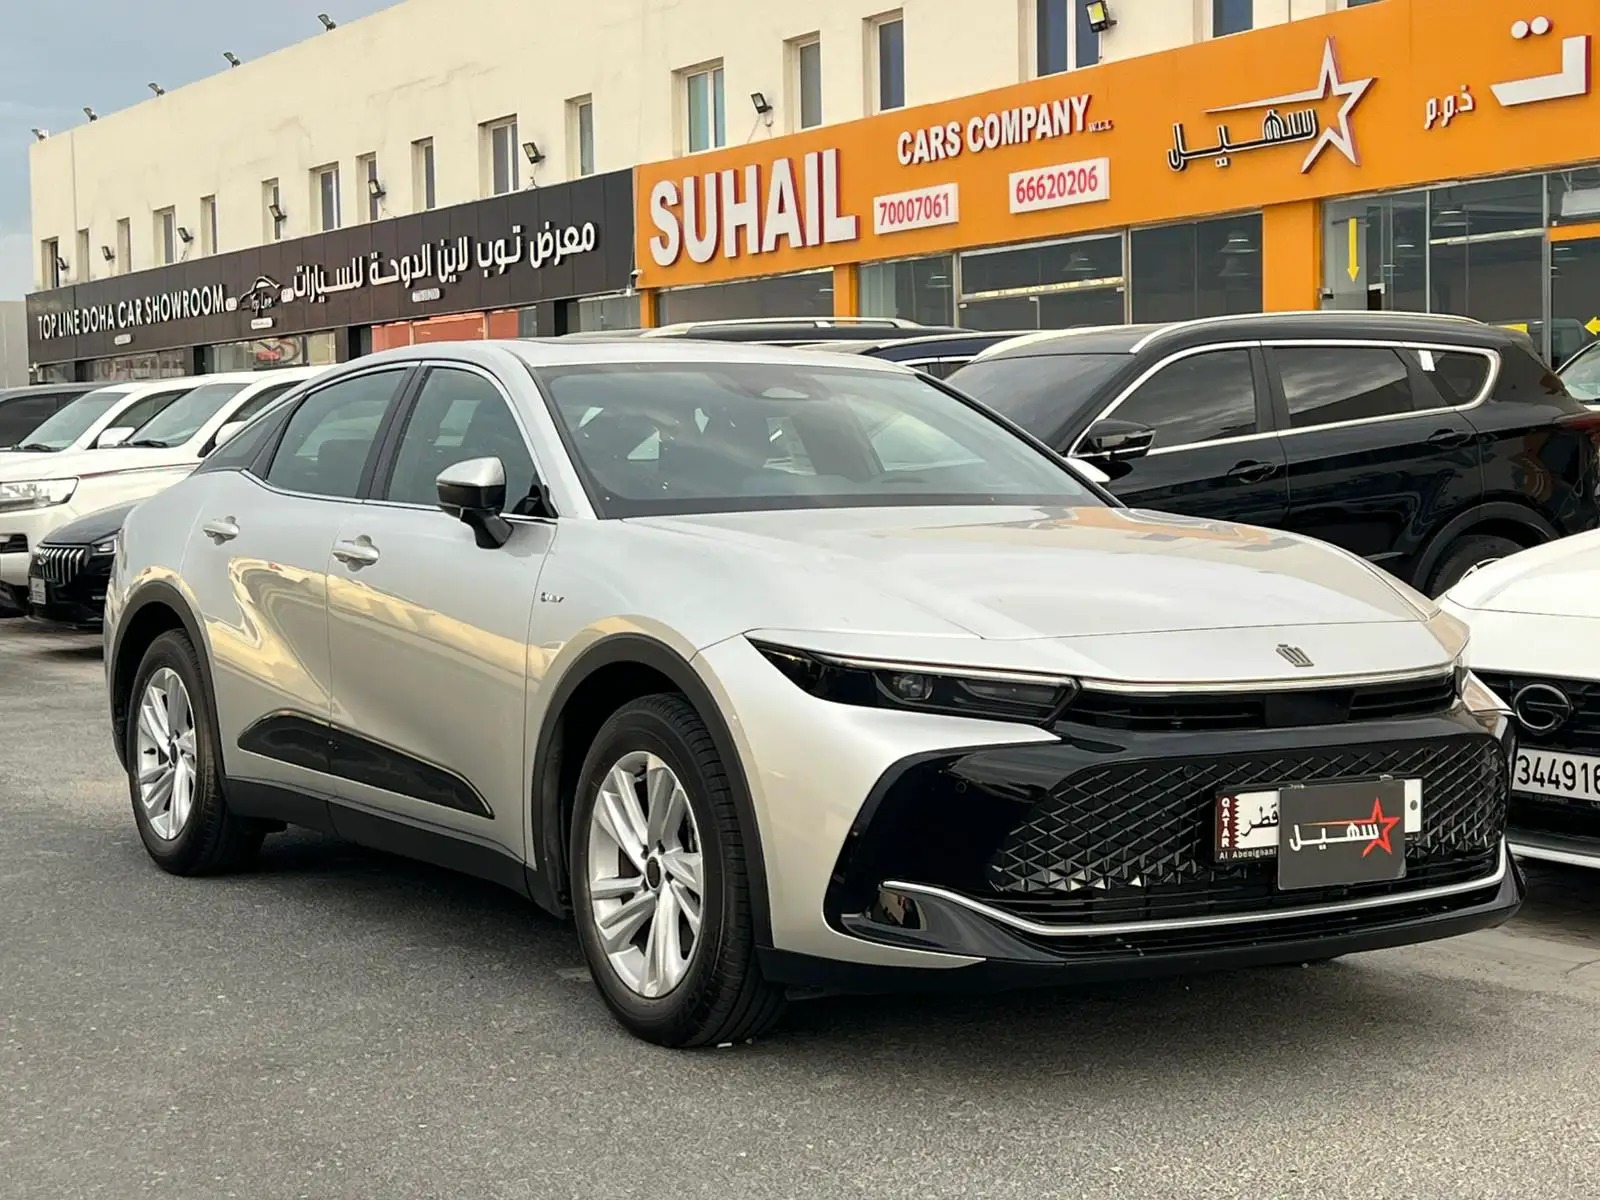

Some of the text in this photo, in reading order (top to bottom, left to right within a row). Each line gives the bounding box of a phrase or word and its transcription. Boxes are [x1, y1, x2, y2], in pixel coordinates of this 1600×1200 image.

[897, 121, 962, 166] CARS
[967, 95, 1091, 152] COMPANY
[1168, 109, 1318, 171] سهيل
[650, 148, 859, 266] SUHAIL
[879, 192, 949, 226] 70007061
[1016, 165, 1098, 204] 66620206
[294, 221, 596, 303] معرض توب لاين الدوحة للسيارات
[38, 314, 56, 340] TOP
[58, 309, 80, 338] LINE
[82, 303, 115, 334] DOHA
[117, 298, 143, 329] CAR
[145, 283, 226, 325] SHOWROOM
[1221, 797, 1231, 848] QATAR
[1240, 803, 1279, 837] قطر
[1289, 822, 1380, 852] سهيل
